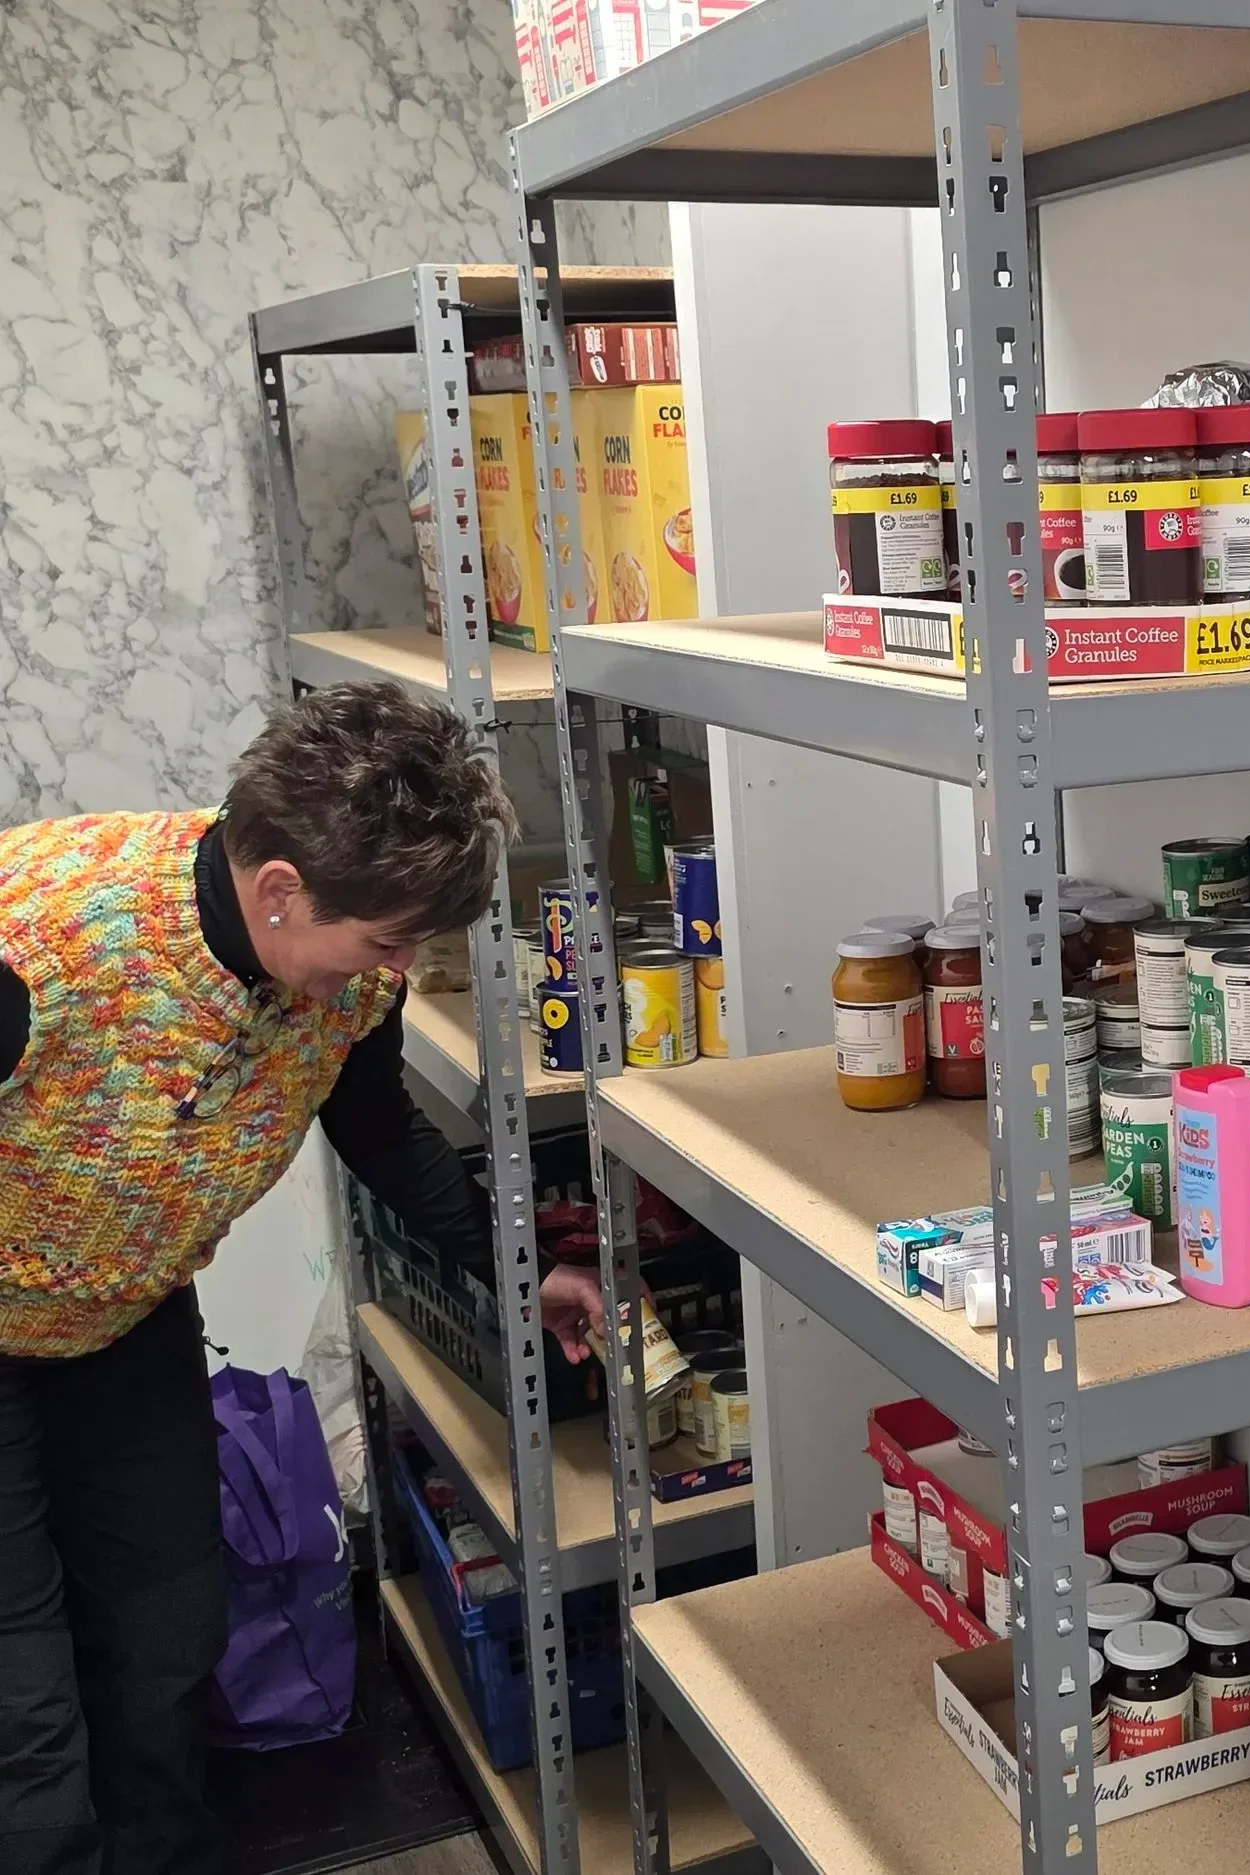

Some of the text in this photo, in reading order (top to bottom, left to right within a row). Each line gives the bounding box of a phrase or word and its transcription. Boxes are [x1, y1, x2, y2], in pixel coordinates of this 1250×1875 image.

[658, 406, 686, 421] CO
[652, 423, 687, 438] FLA
[480, 437, 503, 462] CORN
[604, 435, 631, 464] CORN
[603, 467, 638, 497] FLAKES
[890, 492, 917, 505] £1.69
[1108, 489, 1138, 503] £1.69
[1047, 518, 1077, 528] Coffee
[1236, 516, 1250, 525] 90g
[1103, 524, 1116, 533] 90g
[1061, 536, 1074, 545] 90g
[834, 611, 874, 626] Instant Coffee
[835, 625, 861, 639] Granules
[1064, 628, 1178, 645] Instant Coffee
[1064, 647, 1137, 664] Granules
[1077, 1239, 1092, 1249] 50 ml
[1168, 1486, 1234, 1512] MUSHROOM
[1186, 1499, 1216, 1517] SOUP
[953, 1506, 992, 1547] MUSHROOM
[964, 1525, 982, 1547] SOUP
[945, 1696, 975, 1748] Essentials
[1124, 1736, 1144, 1746] JAM
[1145, 1741, 1250, 1787] STRAWBERRY
